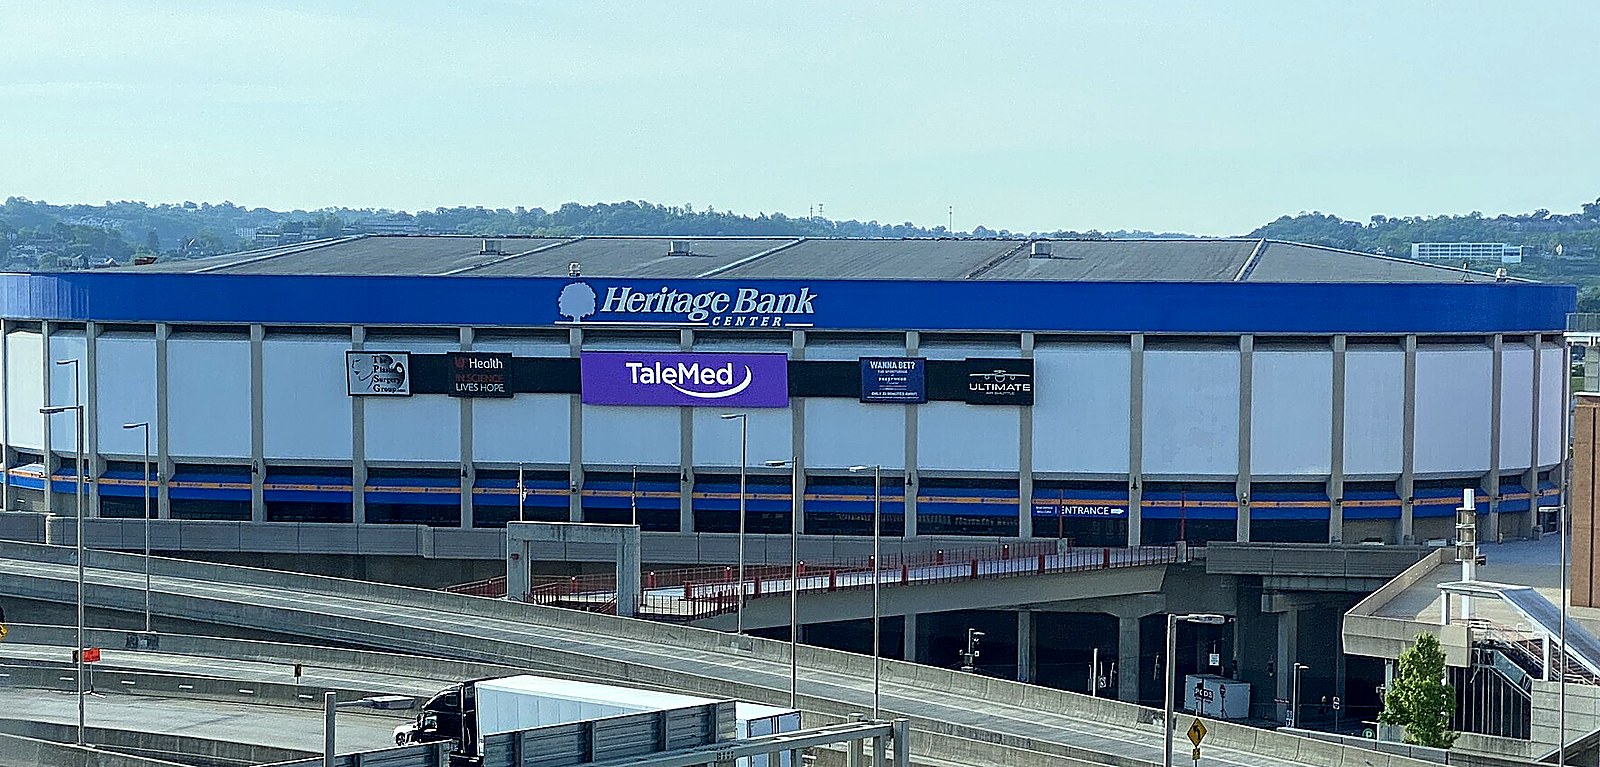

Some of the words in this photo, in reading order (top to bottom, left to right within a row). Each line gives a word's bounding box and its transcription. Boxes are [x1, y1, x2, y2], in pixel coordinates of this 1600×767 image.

[600, 286, 730, 322] Heritage
[732, 287, 818, 314] Bank
[712, 316, 782, 327] CENTER
[372, 355, 388, 364] The
[469, 358, 503, 369] Health
[625, 362, 734, 386] TaleMed
[373, 375, 401, 385] Surgery
[455, 383, 479, 392] LIVES
[480, 383, 505, 392] HOPE
[969, 383, 1031, 392] ULTIMATE
